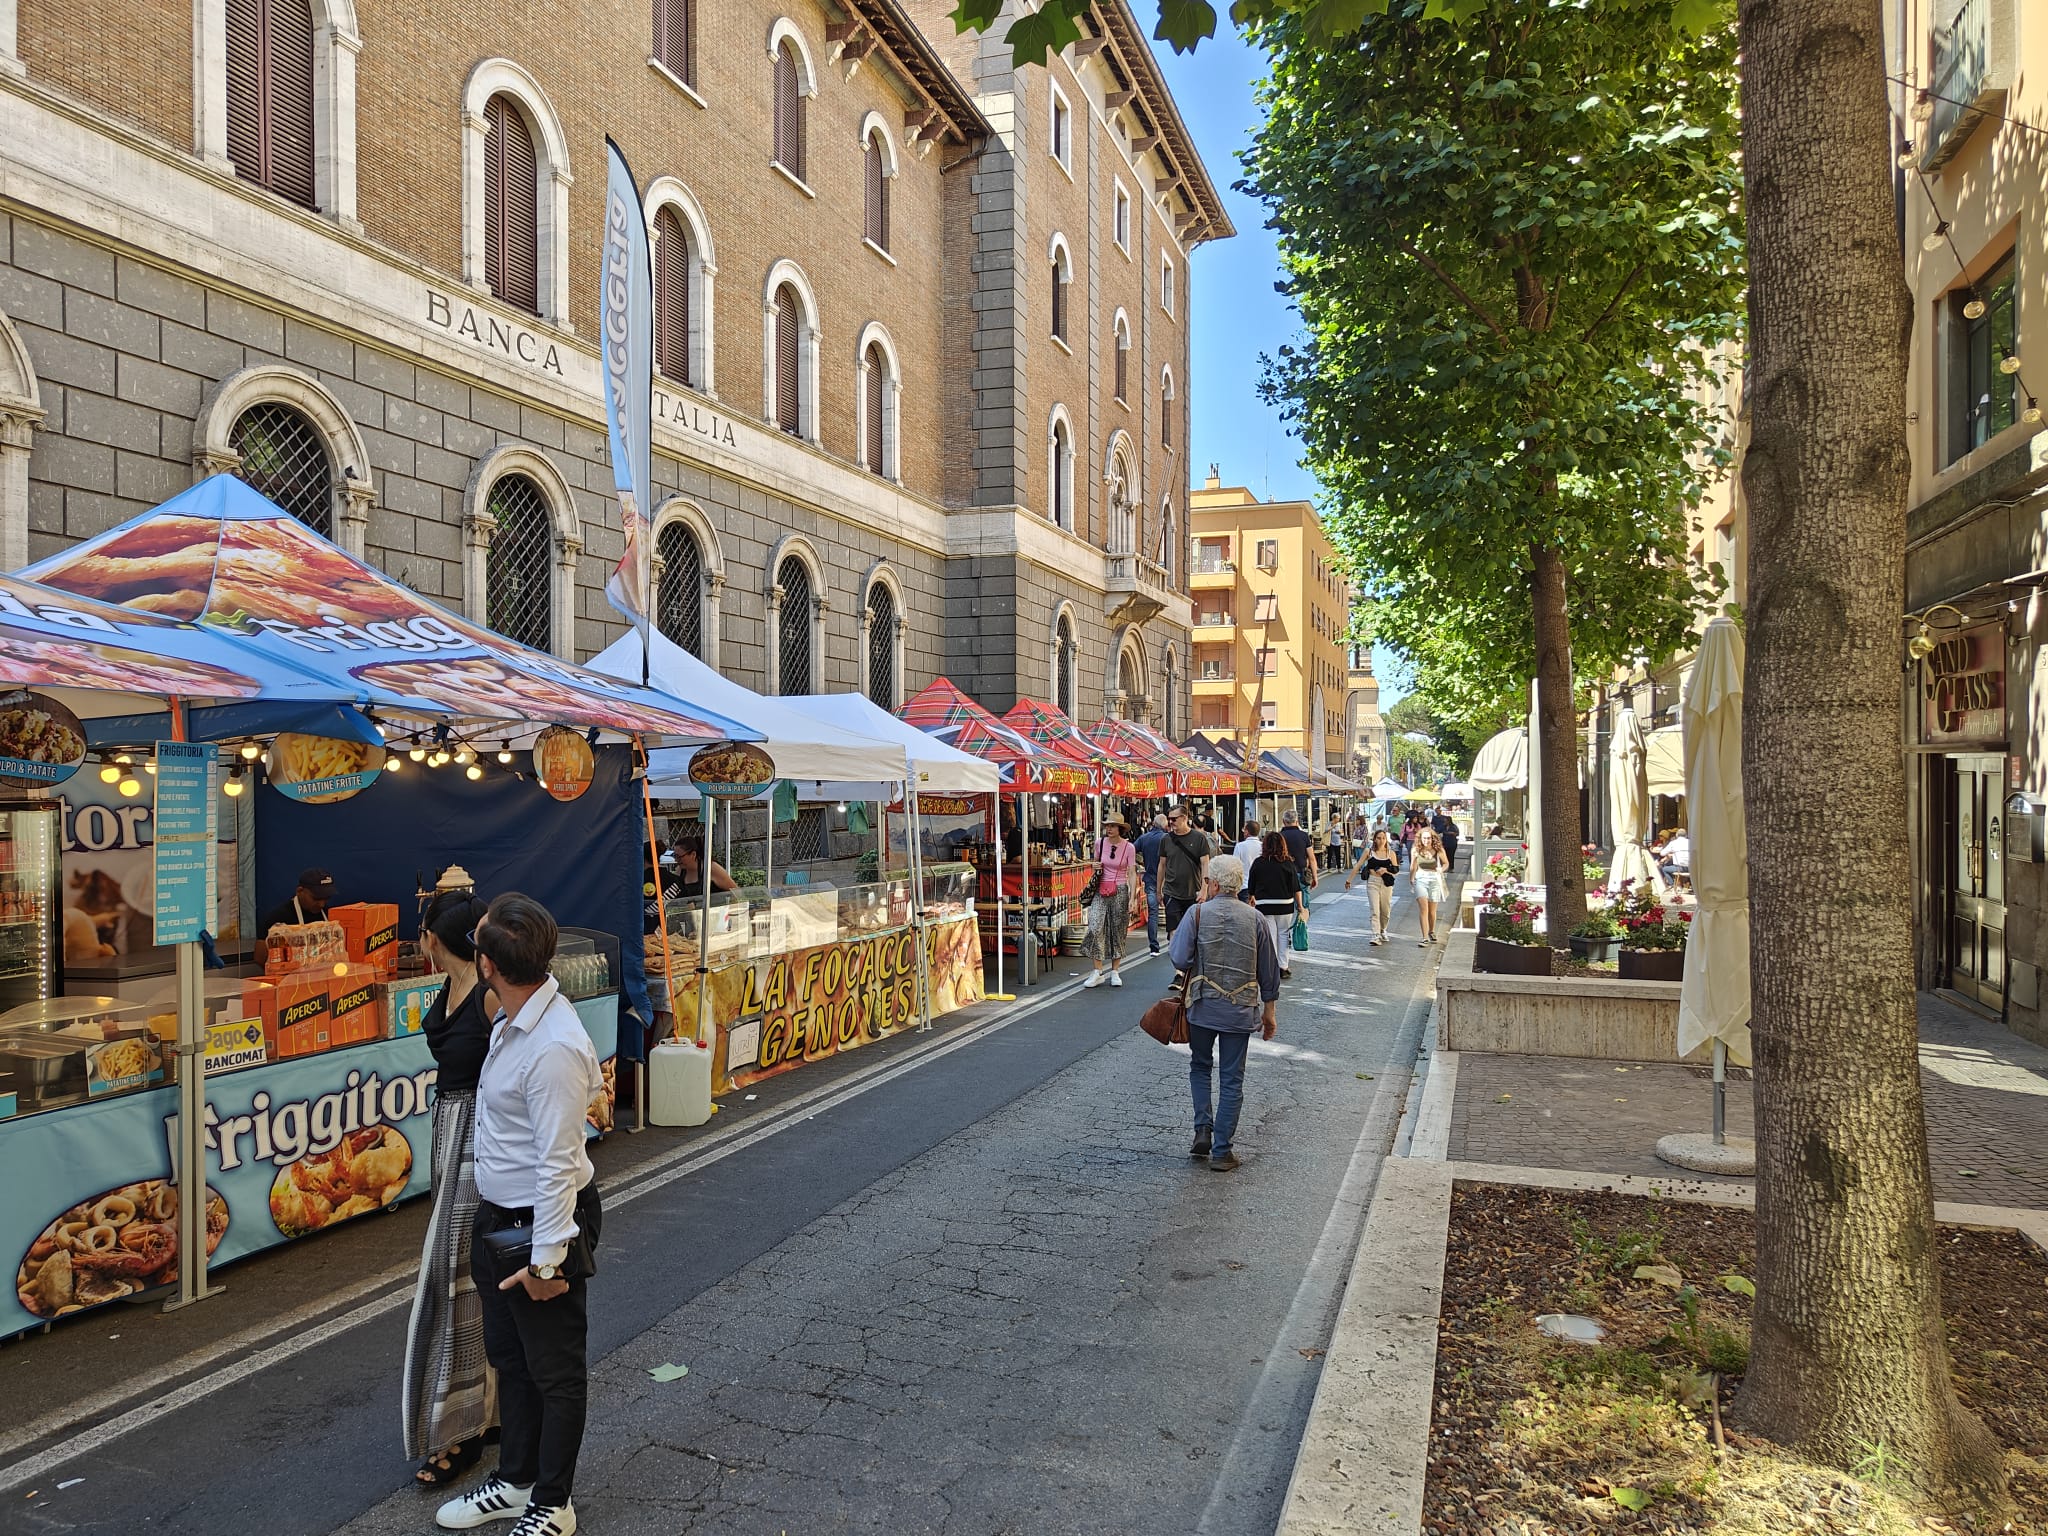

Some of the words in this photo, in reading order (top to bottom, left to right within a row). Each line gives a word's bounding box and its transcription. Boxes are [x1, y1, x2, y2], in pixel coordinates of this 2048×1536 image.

[426, 289, 564, 376] BANCA
[653, 391, 737, 448] TALIA
[1936, 673, 1991, 732] GLASS
[1982, 713, 1998, 735] Pub
[160, 744, 204, 758] FRIGGITORIA
[0, 760, 16, 773] LPO
[27, 764, 56, 778] PATATE
[297, 780, 333, 795] PATATINE
[334, 775, 362, 790] FRITTE
[708, 784, 725, 792] POLPO
[733, 784, 754, 793] PATATE
[369, 926, 394, 948] APEROL
[740, 959, 786, 1017] LA
[284, 1001, 323, 1025] APEROL
[336, 990, 370, 1016] APEROL
[205, 1049, 264, 1071] BANCOMAT
[107, 1077, 130, 1088] PATATINE
